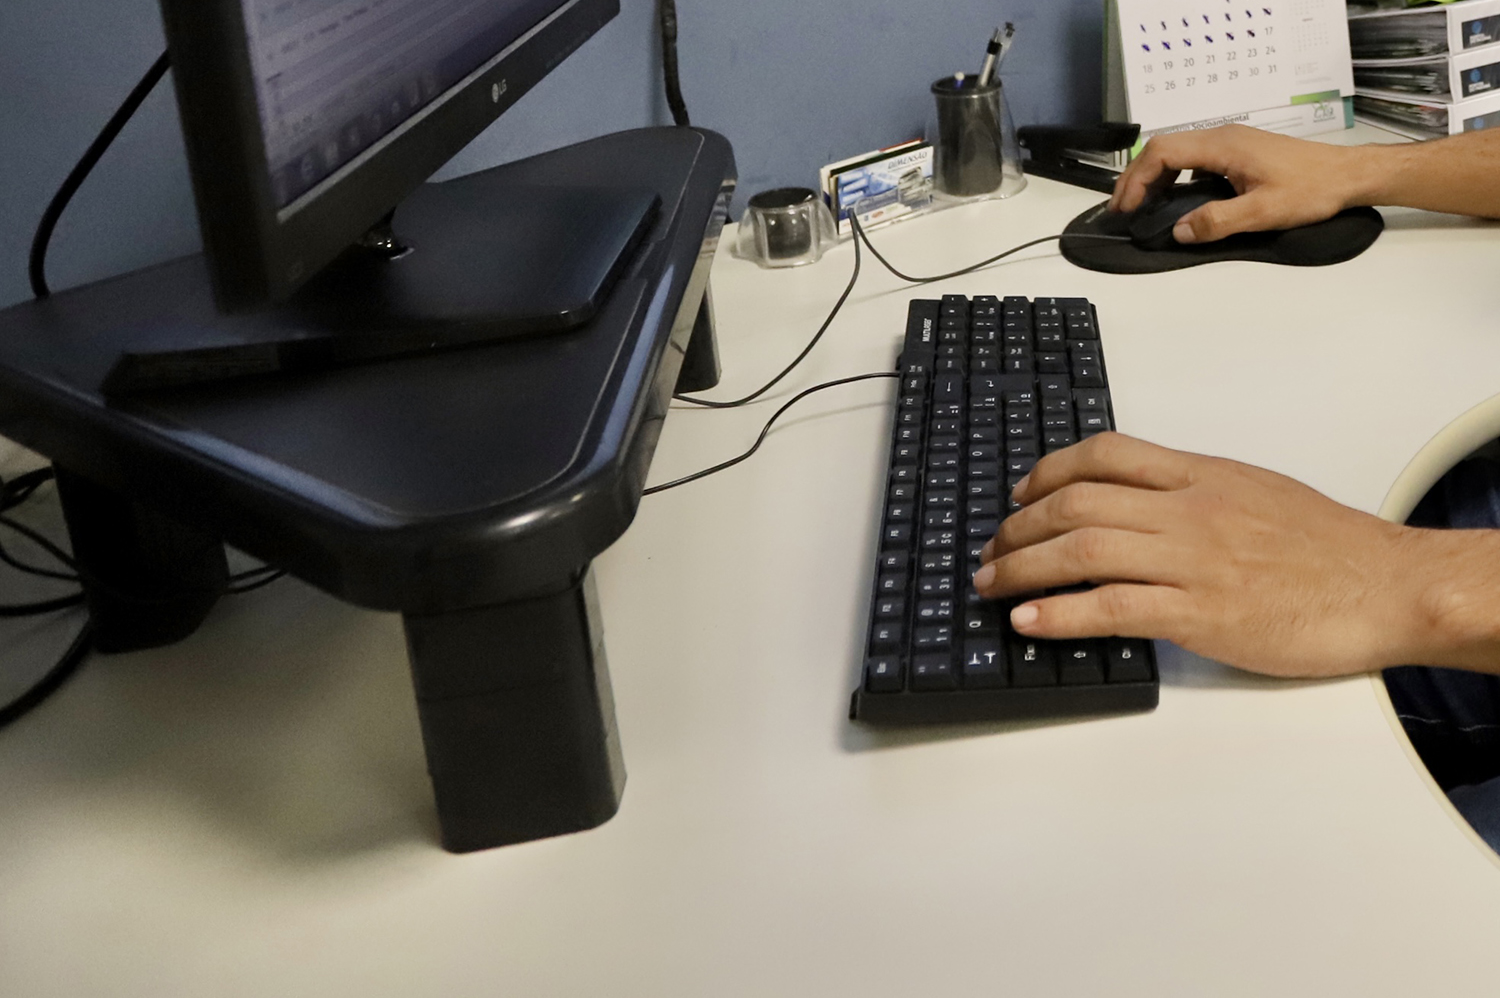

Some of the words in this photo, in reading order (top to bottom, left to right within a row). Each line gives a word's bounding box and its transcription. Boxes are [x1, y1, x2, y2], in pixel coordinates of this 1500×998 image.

[1264, 27, 1273, 35] 17
[1143, 64, 1153, 74] 18
[1163, 61, 1173, 70] 19
[1184, 57, 1195, 67] 20
[1206, 55, 1215, 64] 21
[1227, 52, 1236, 61] 22
[1247, 49, 1257, 58] 23
[1265, 46, 1275, 55] 24
[1145, 84, 1155, 94] 25
[1165, 81, 1176, 90] 26
[1186, 77, 1196, 87] 27
[1207, 74, 1218, 83] 28
[1228, 71, 1238, 80] 29
[1249, 67, 1259, 77] 30
[1268, 65, 1277, 74] 31
[1192, 113, 1249, 130] Socioambiental
[885, 580, 894, 588] F3
[882, 604, 891, 612] F2
